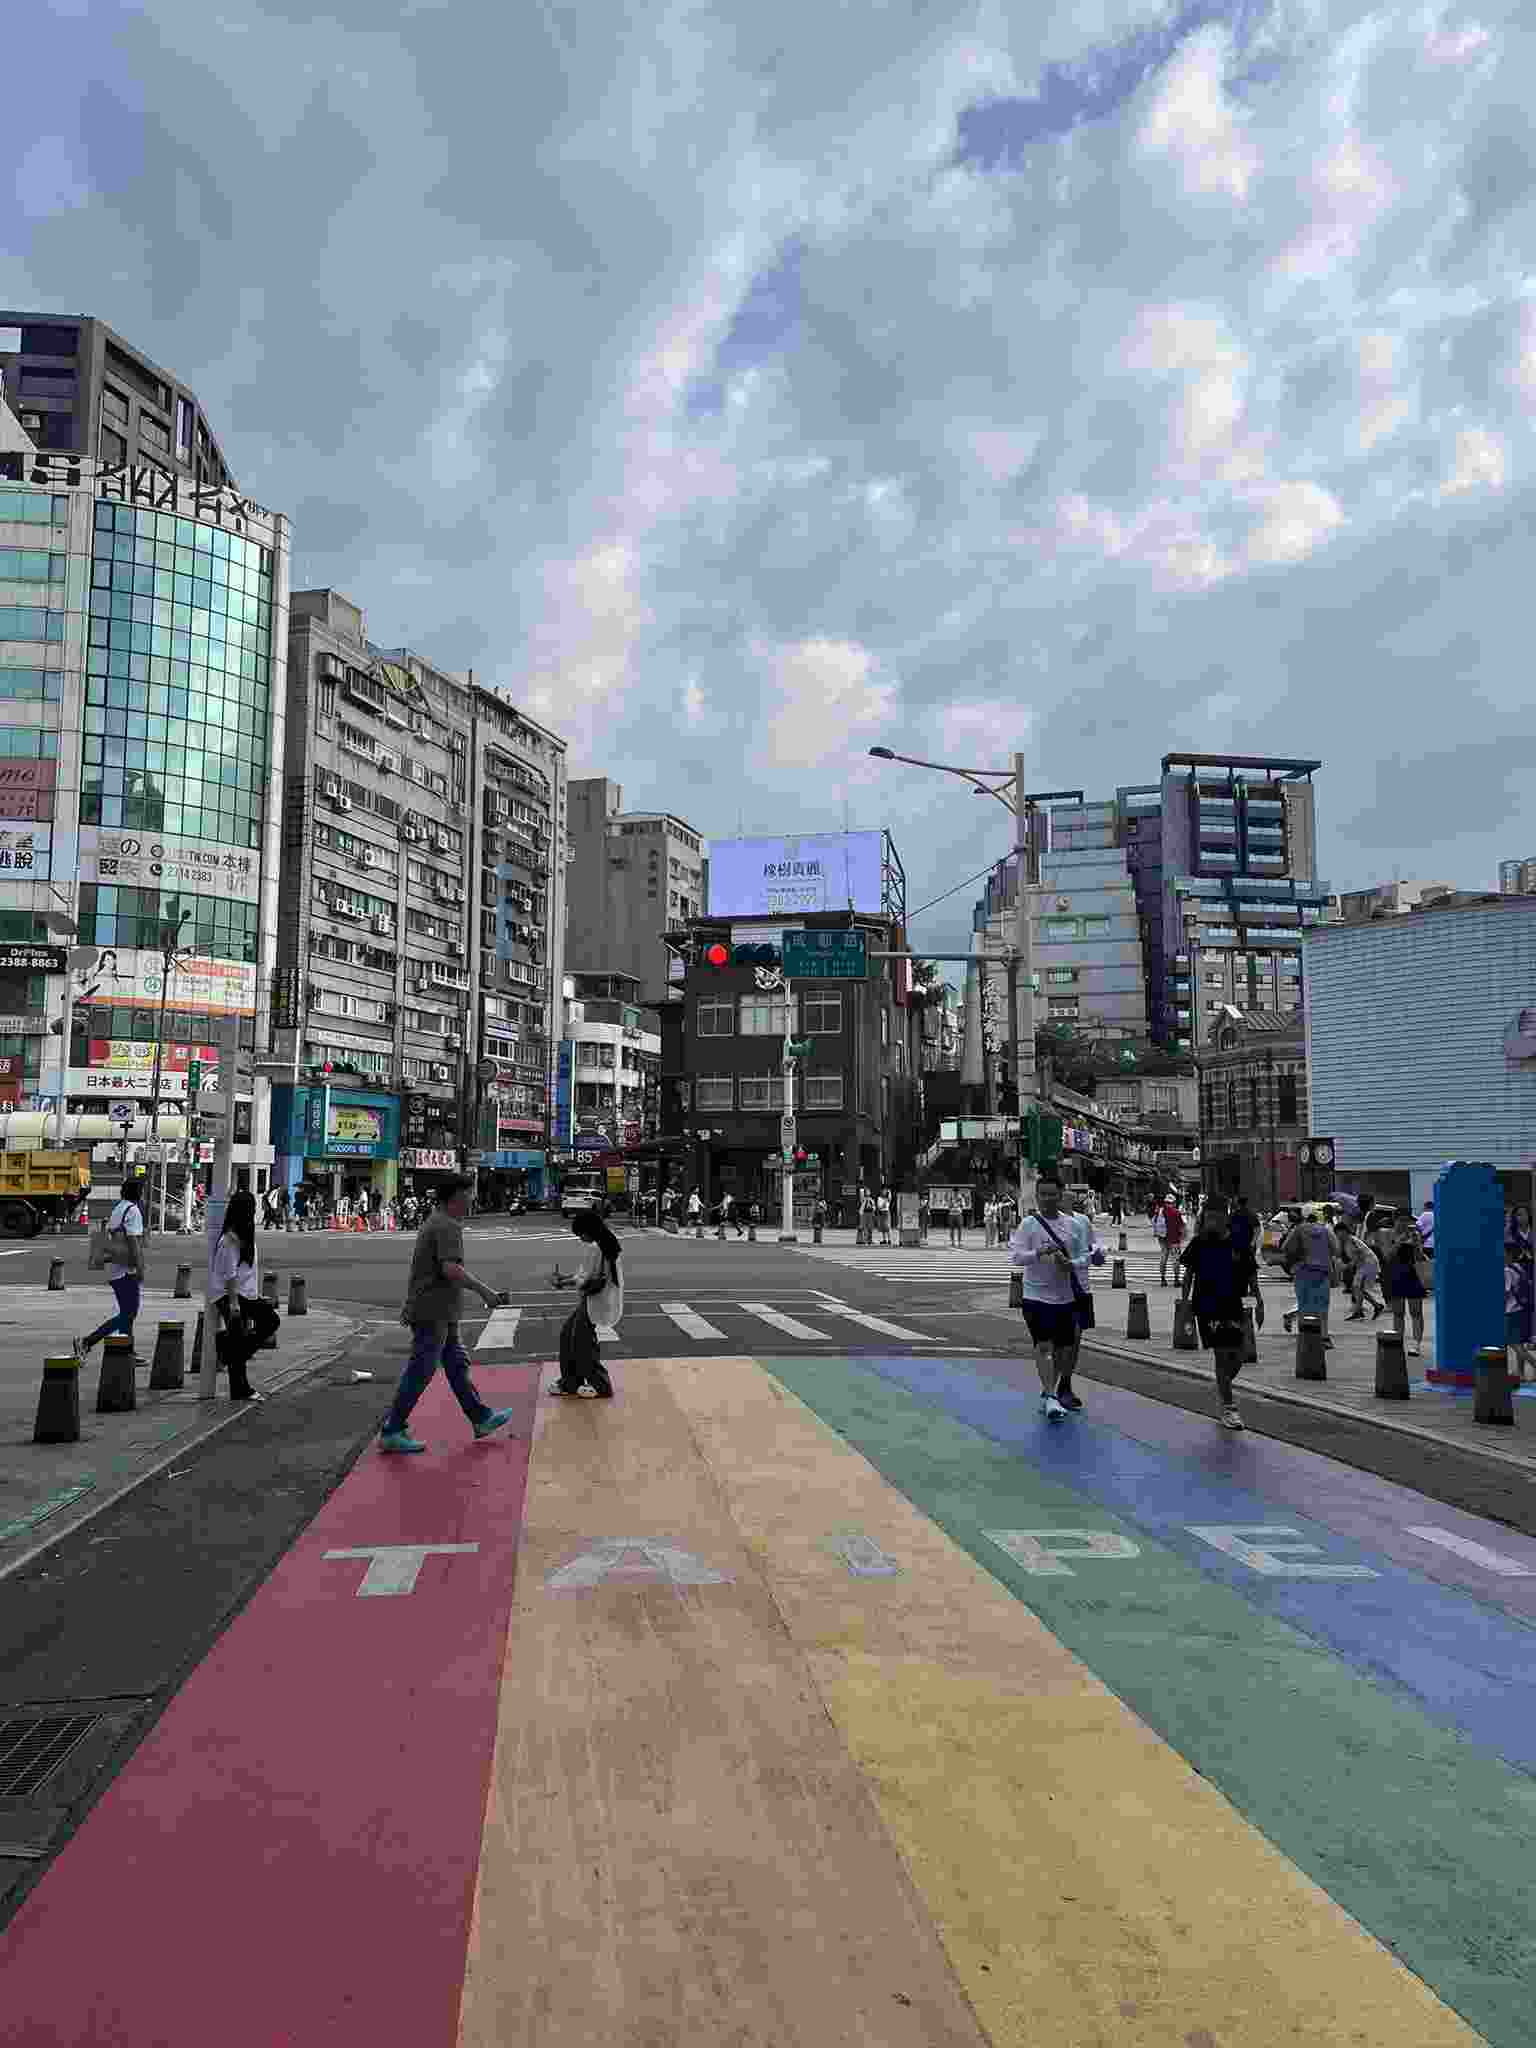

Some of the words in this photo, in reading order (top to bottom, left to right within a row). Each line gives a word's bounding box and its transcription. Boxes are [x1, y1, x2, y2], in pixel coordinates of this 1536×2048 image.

[87, 1075, 172, 1090] 日本最大二店
